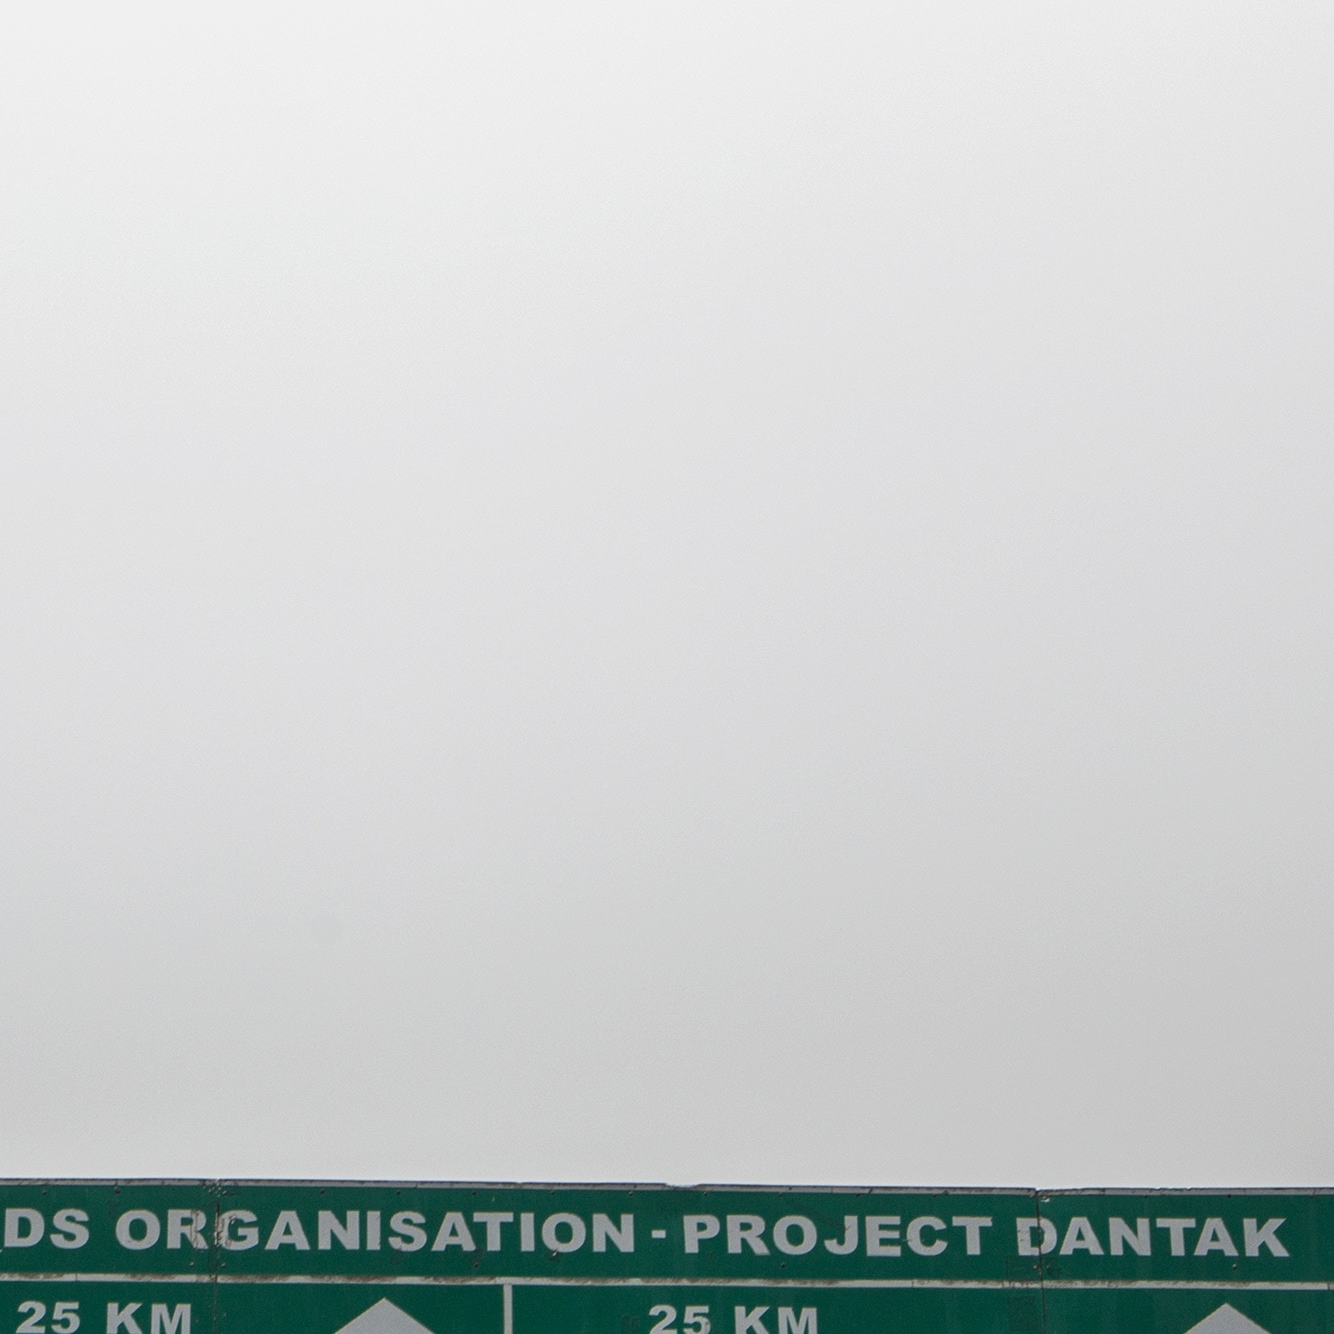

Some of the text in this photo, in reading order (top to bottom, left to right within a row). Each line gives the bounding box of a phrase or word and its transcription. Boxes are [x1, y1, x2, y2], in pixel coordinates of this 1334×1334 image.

[115, 1208, 635, 1253] ORGANISATION
[683, 1214, 993, 1257] PROJECT
[1015, 1216, 1290, 1257] DANTAK
[15, 1300, 81, 1334] 25
